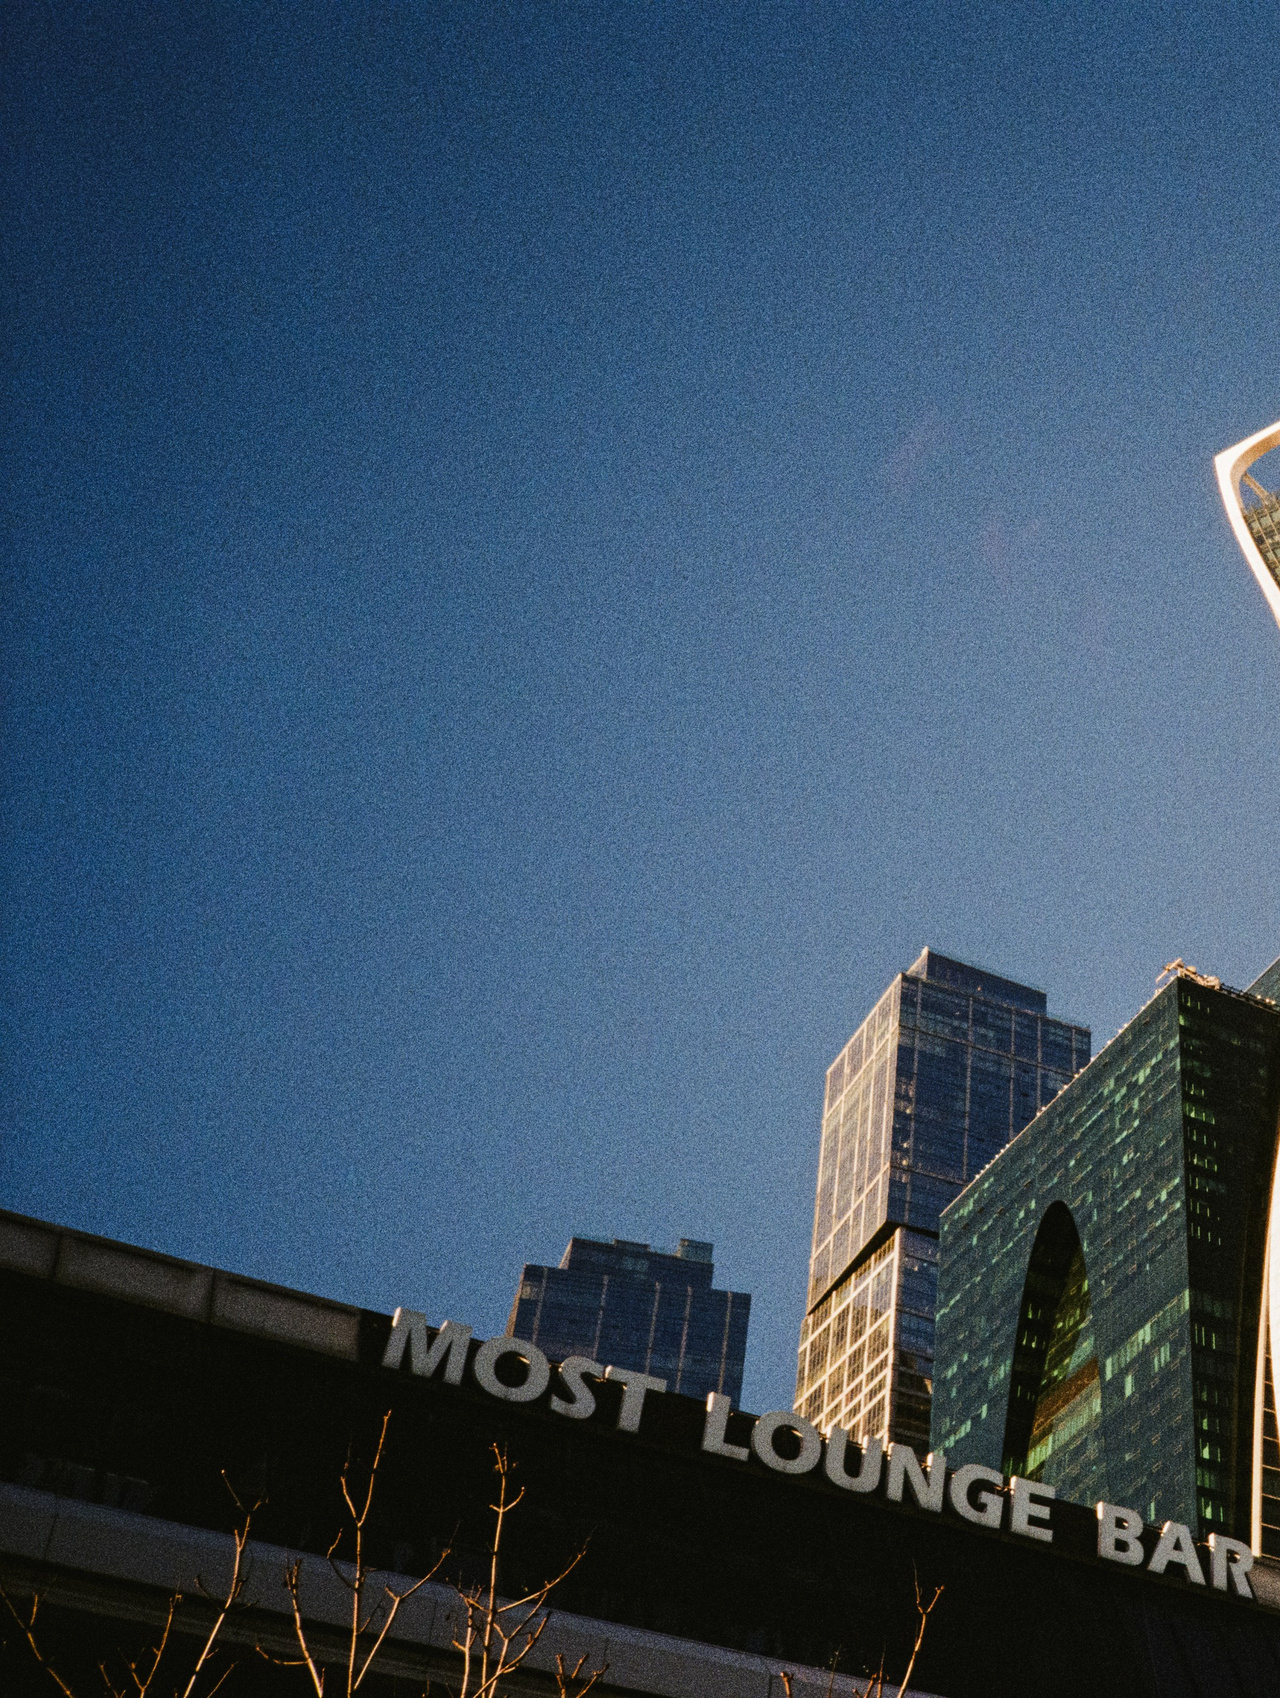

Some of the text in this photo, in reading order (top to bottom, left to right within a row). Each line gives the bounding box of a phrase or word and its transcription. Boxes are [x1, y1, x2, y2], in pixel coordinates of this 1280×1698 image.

[381, 1306, 1254, 1599] MOST LOUNGE BAR
